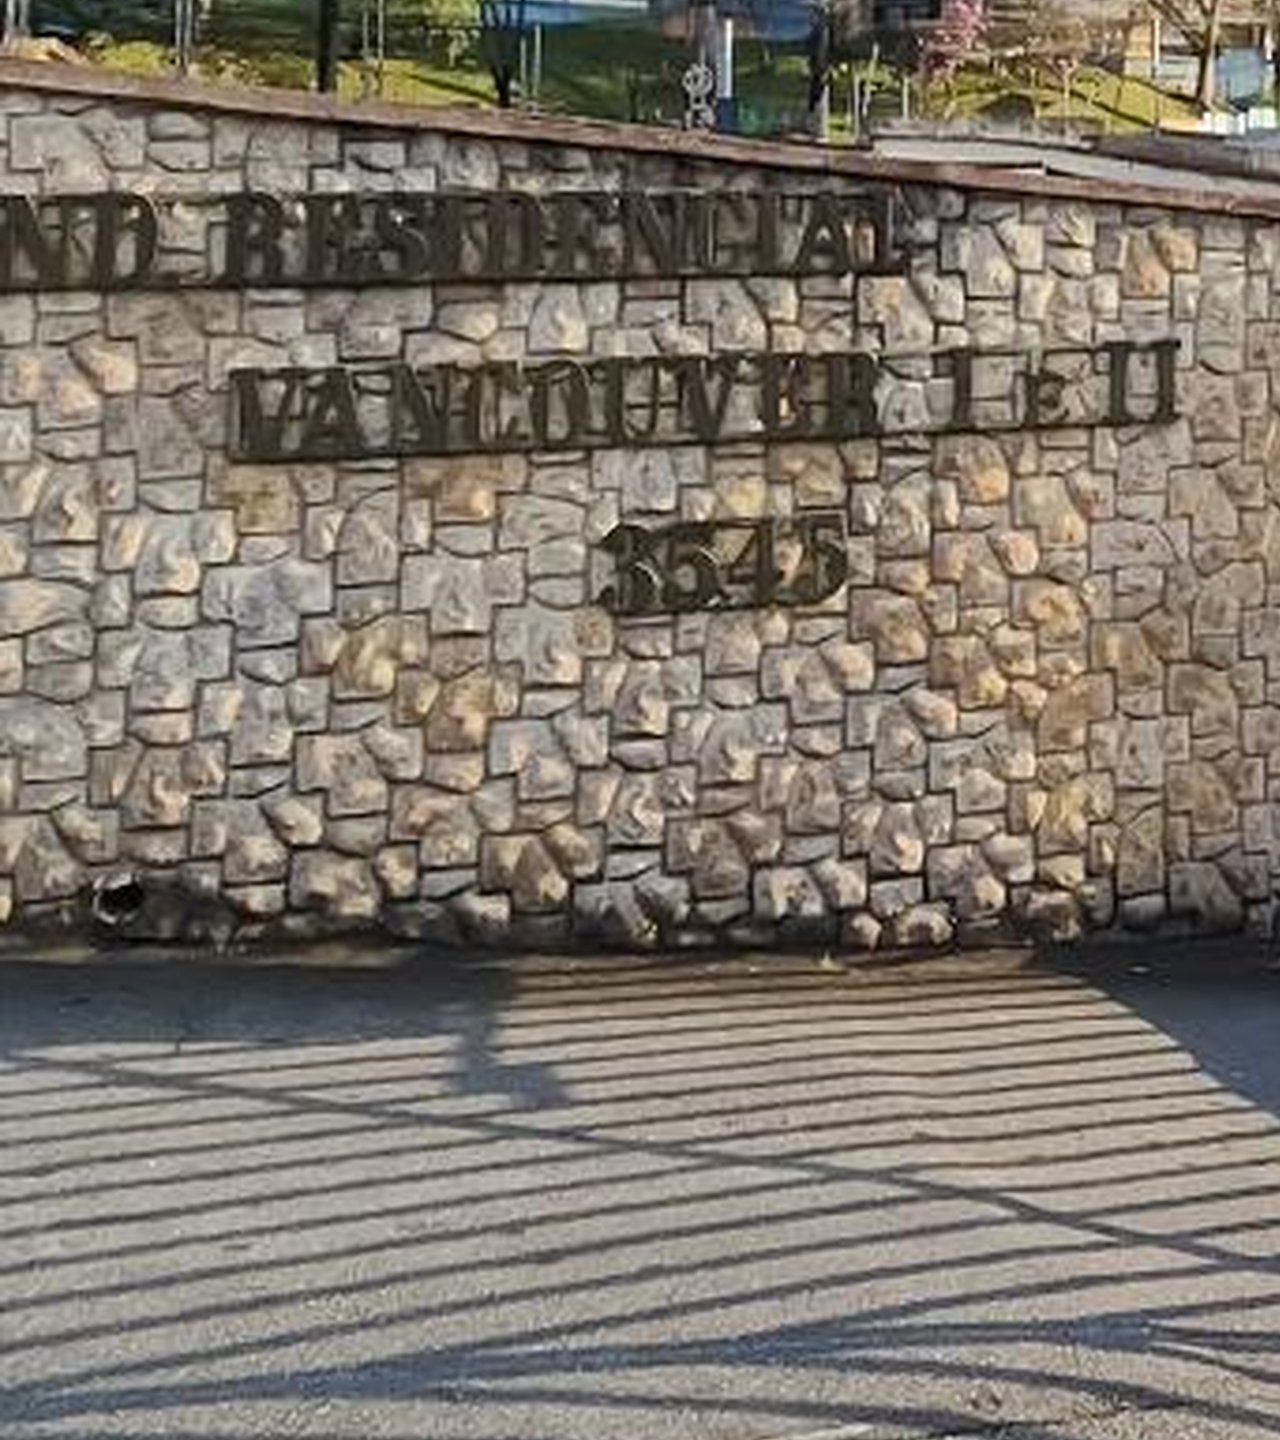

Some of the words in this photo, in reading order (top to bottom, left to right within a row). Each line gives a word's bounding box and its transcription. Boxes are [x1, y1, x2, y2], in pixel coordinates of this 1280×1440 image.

[216, 187, 905, 291] RESIDENCIAL
[229, 354, 880, 461] VANCOUVER
[602, 520, 849, 616] 3545
